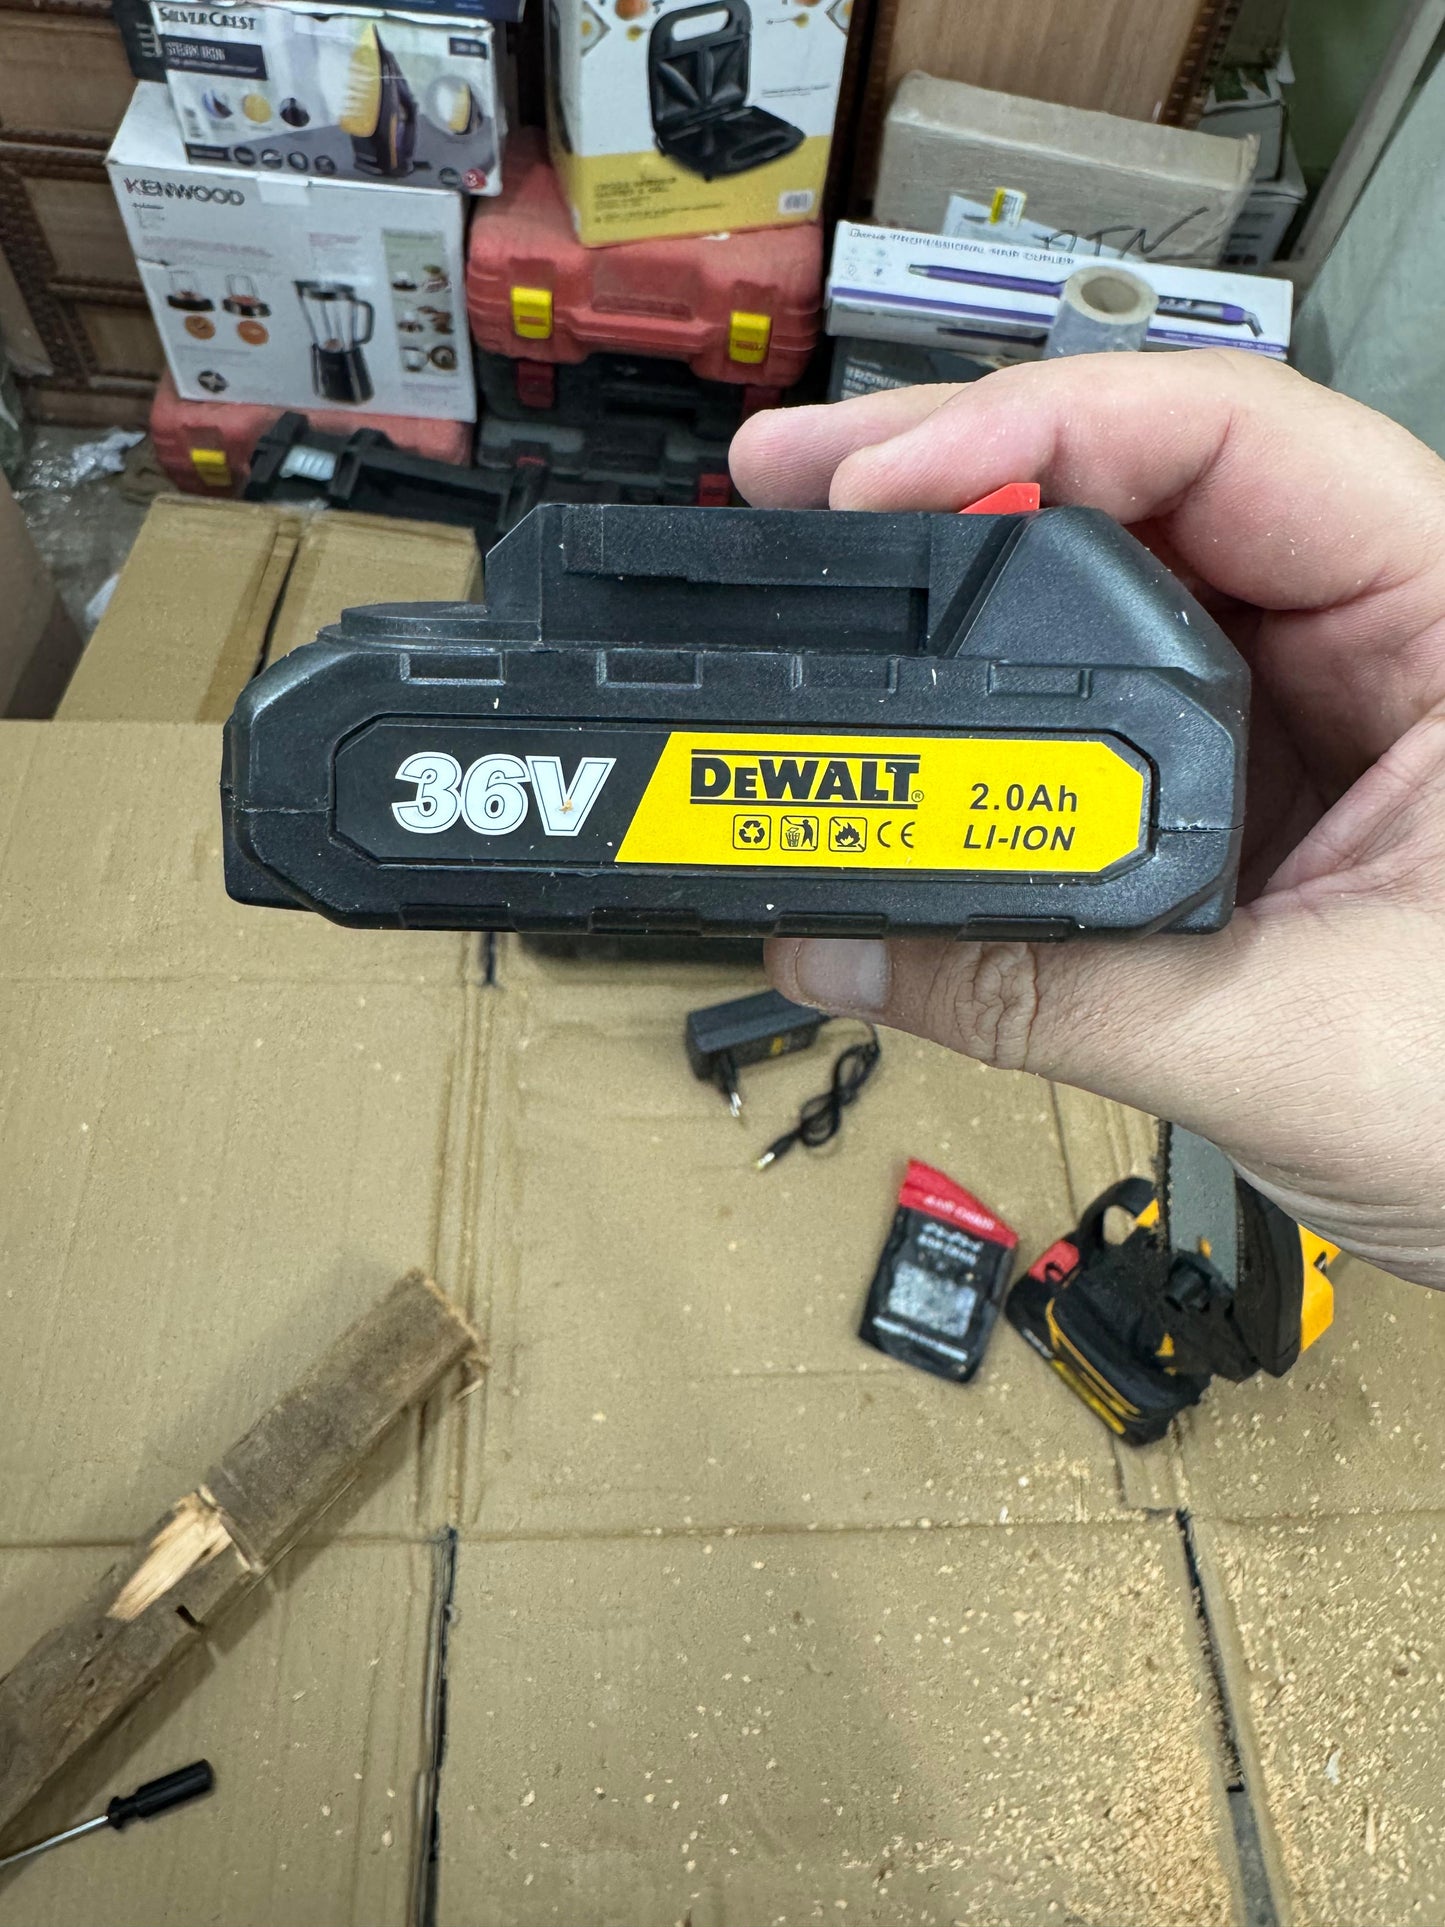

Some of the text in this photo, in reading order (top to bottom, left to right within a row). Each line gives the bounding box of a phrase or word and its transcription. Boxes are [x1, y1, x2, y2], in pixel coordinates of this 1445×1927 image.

[124, 178, 245, 206] KENWOOD
[391, 751, 617, 836] 36V
[969, 783, 1077, 812] 2.0Ah
[963, 824, 1075, 851] LI-ION
